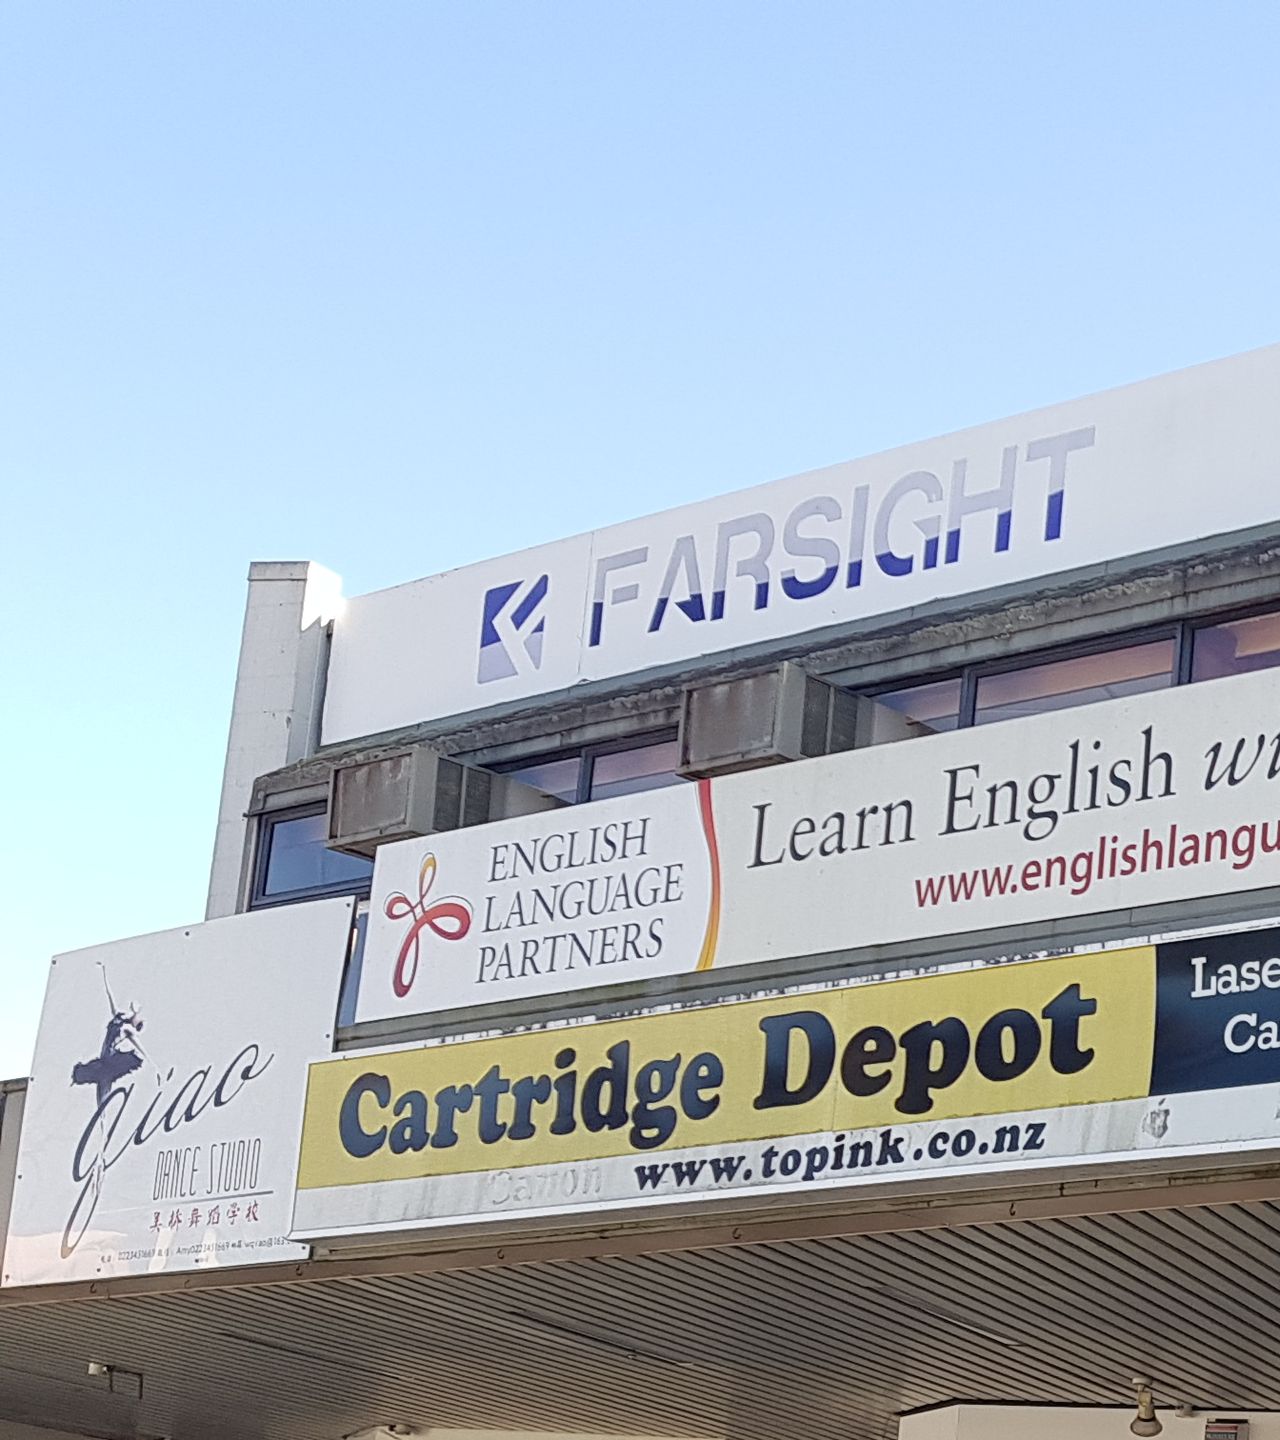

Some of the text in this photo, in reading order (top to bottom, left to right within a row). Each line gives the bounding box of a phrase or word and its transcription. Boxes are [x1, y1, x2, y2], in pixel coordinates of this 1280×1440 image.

[589, 426, 1095, 647] FARSIGHT
[747, 800, 916, 869] Learn
[939, 725, 1178, 842] English
[490, 818, 650, 884] ENGLISH
[482, 864, 684, 933] LANGUAGE
[476, 917, 663, 984] PARTNERS
[339, 983, 1096, 1158] Cartridge Depot
[153, 1138, 261, 1200] DANCE STUDIO
